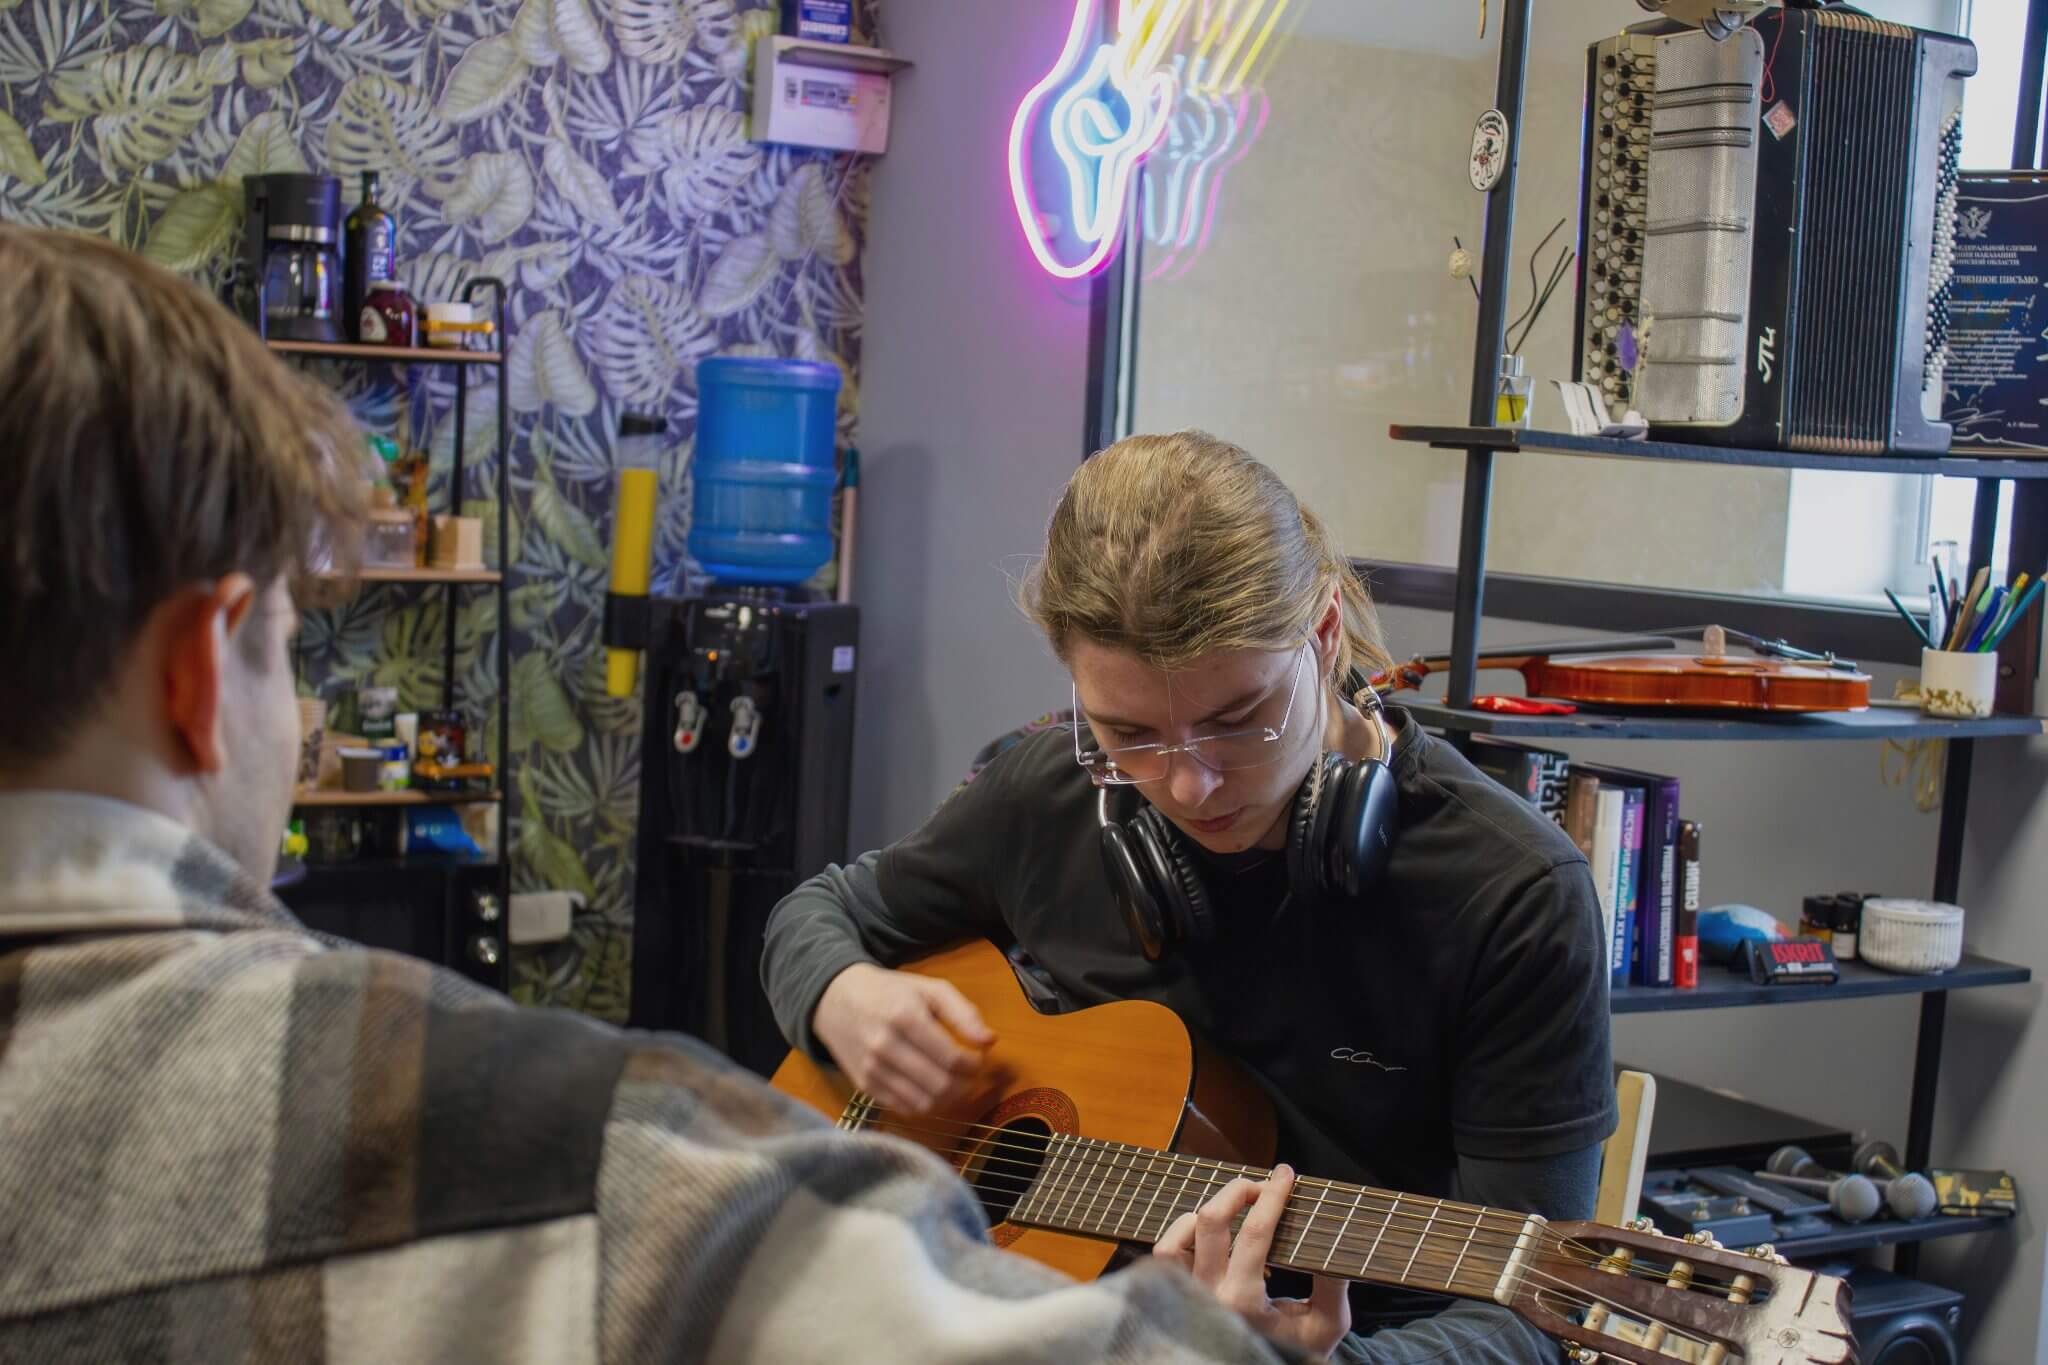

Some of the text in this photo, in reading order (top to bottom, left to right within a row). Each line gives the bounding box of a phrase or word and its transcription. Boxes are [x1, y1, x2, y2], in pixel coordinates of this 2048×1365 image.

[1999, 276, 2039, 284] ПИСЬМО
[1622, 809, 1635, 864] ИСТОРИЯ
[1612, 937, 1624, 969] ВЕКА
